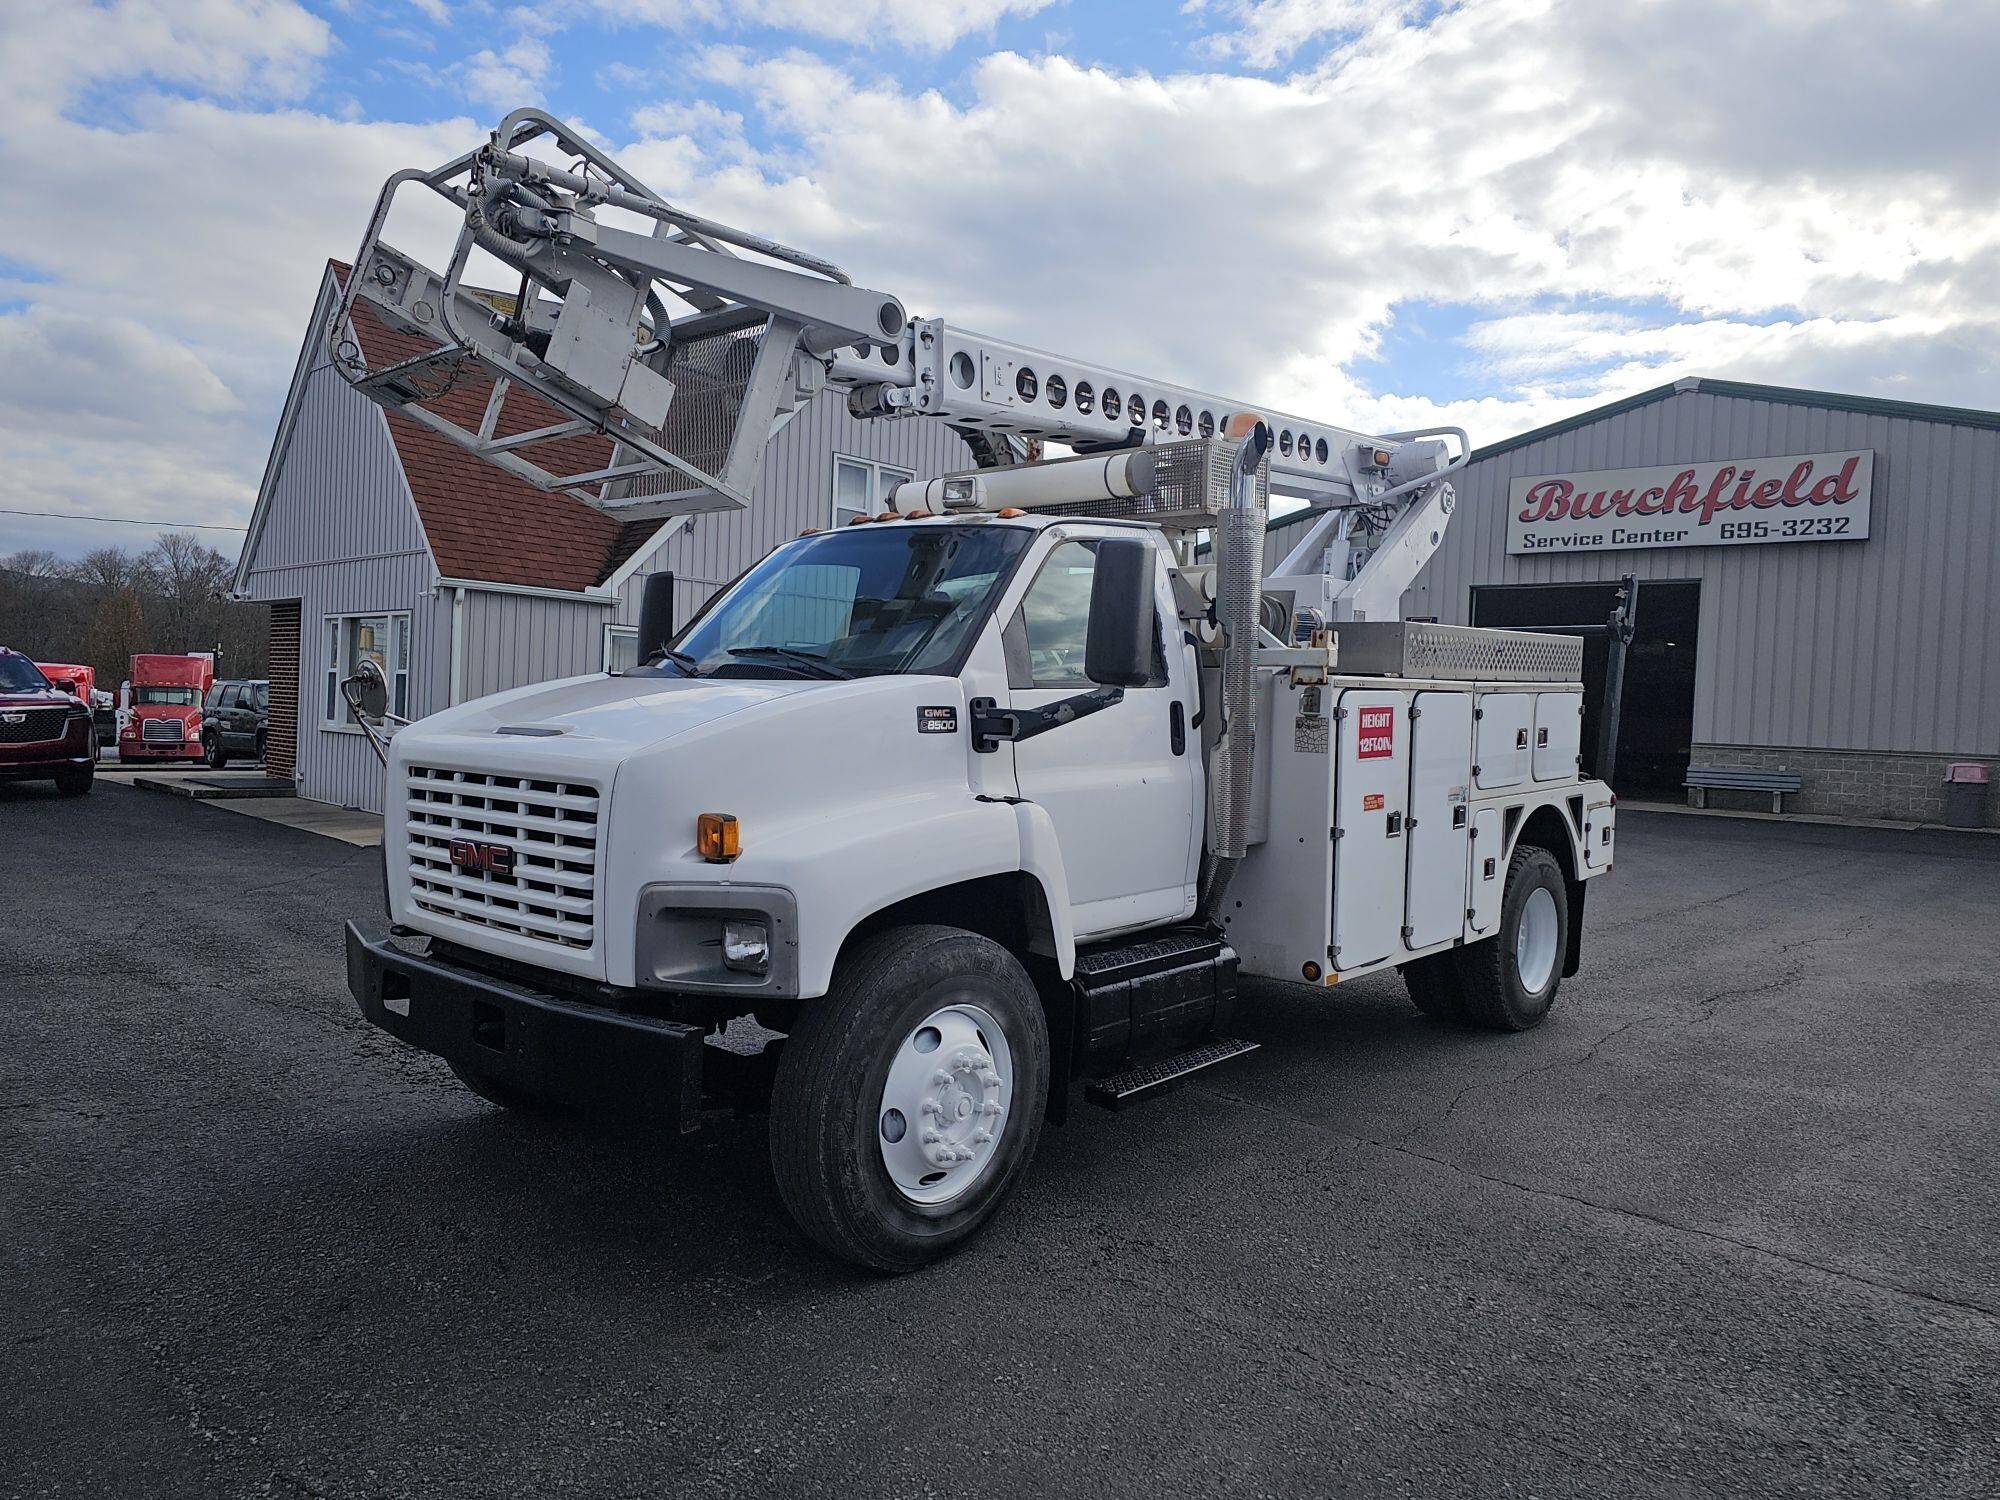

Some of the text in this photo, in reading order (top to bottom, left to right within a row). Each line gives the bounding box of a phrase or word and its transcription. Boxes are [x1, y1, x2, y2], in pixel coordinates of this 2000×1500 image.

[1519, 455, 1860, 526] Burchfield
[1523, 516, 1850, 549] Service Center 695-3232
[920, 720, 956, 731] C8500
[924, 709, 951, 718] GMC
[1361, 713, 1391, 729] HEIGHT
[449, 839, 509, 873] GMC
